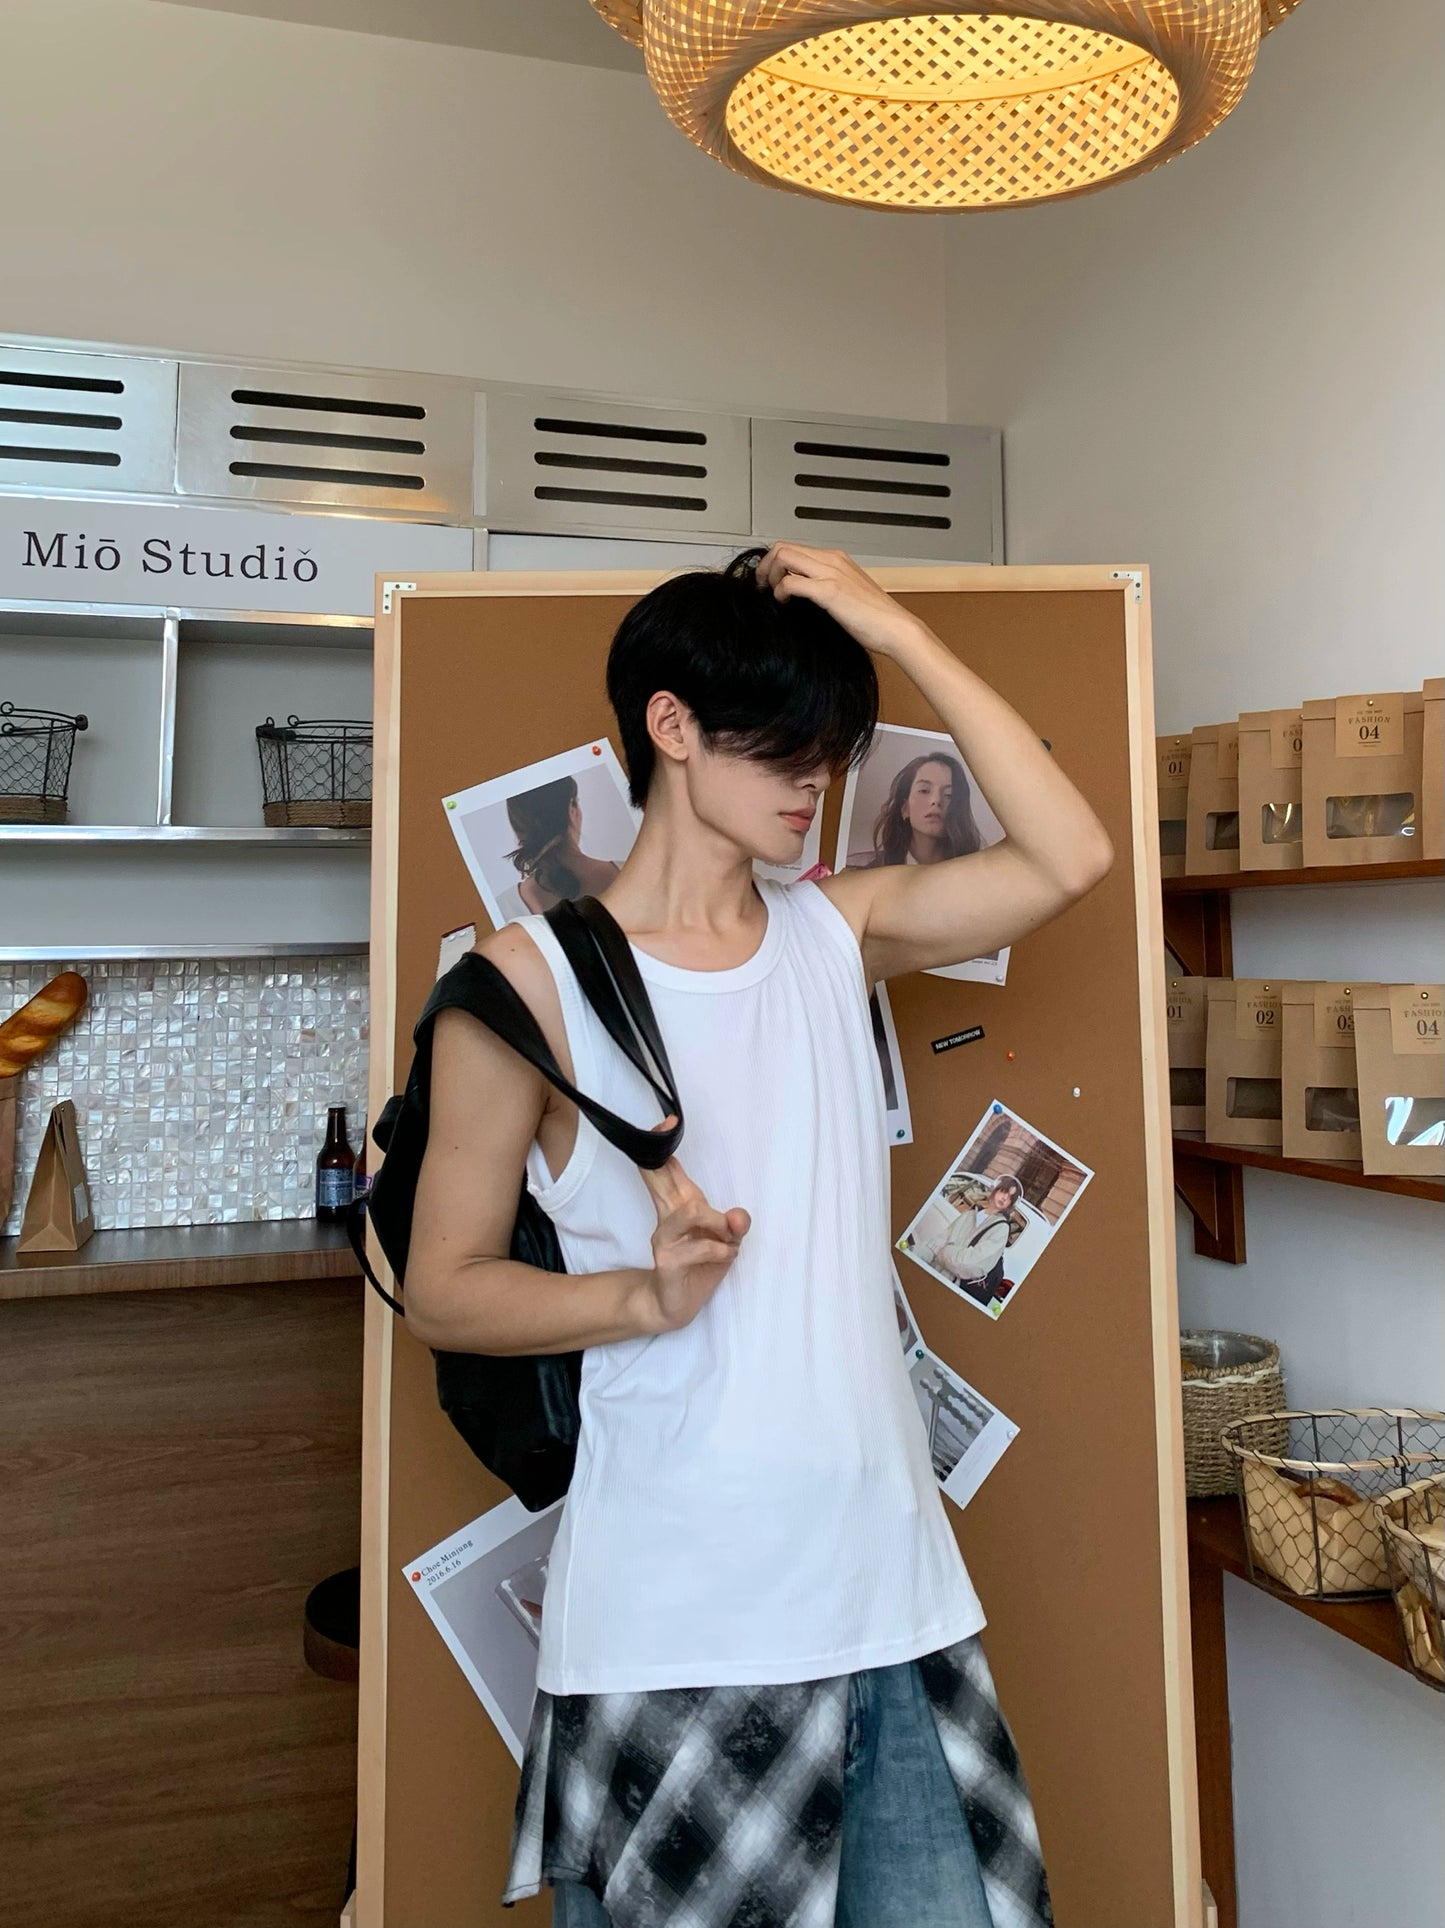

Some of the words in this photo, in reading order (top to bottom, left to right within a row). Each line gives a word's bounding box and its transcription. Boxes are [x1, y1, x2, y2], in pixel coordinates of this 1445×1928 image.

[22, 531, 121, 571] Miō
[1348, 716, 1391, 725] FASHION
[1359, 725, 1380, 740] 04
[1293, 738, 1303, 752] 0
[1168, 761, 1183, 774] 01
[1167, 1005, 1183, 1018] 01
[1256, 1010, 1274, 1025] 02
[1404, 1009, 1443, 1018] FASHIO
[1417, 1020, 1439, 1036] 04
[935, 1040, 949, 1050] NEW
[440, 1540, 474, 1564] Minjung
[427, 1559, 462, 1586] 2016.6.16
